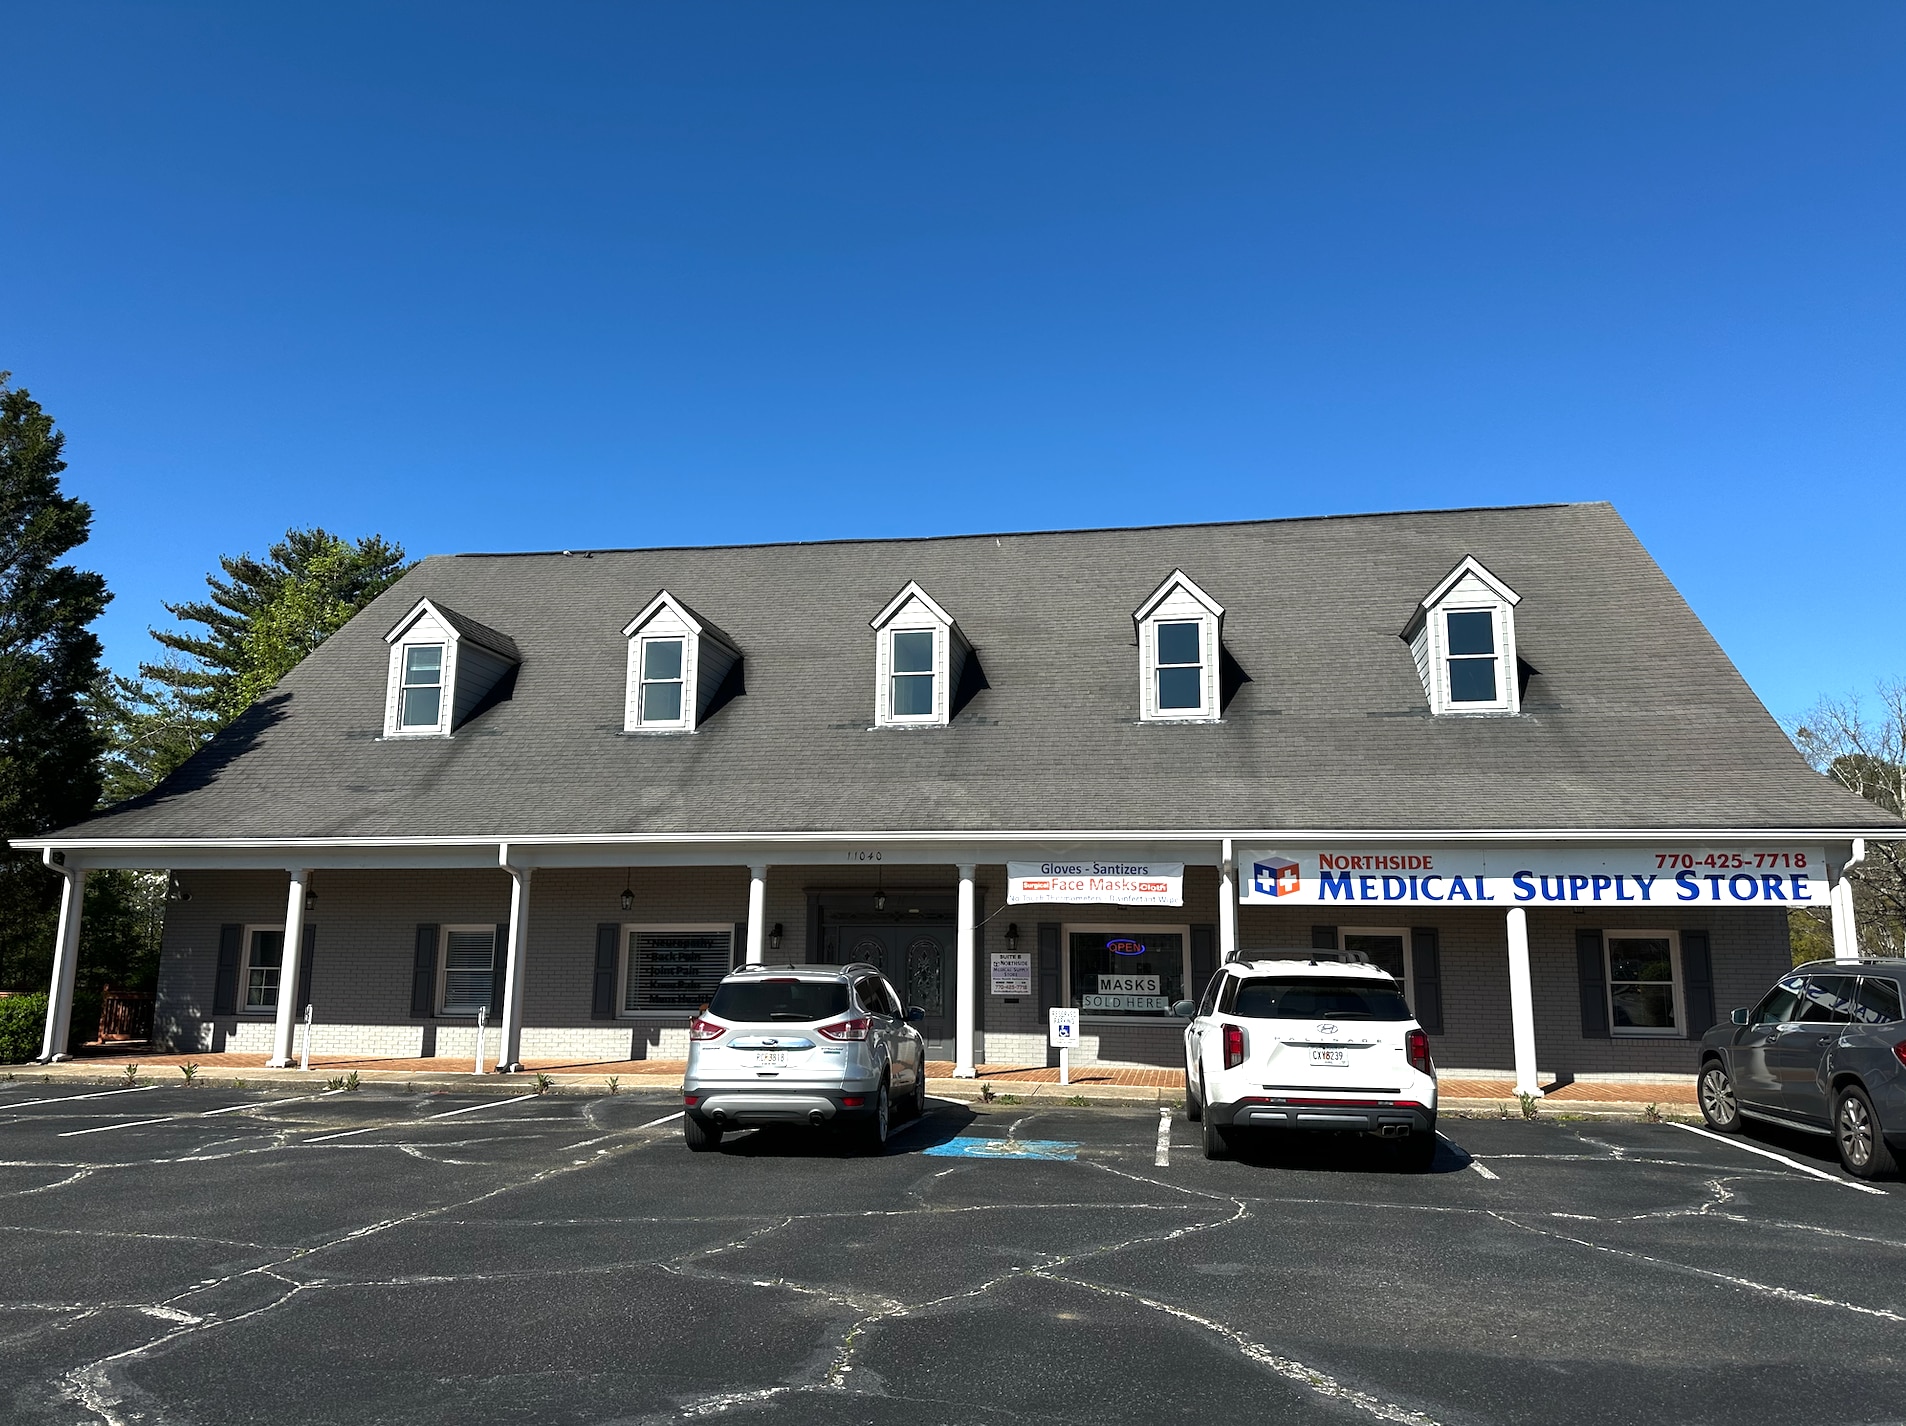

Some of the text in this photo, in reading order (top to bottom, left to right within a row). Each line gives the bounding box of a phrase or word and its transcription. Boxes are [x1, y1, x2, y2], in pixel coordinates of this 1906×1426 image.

[848, 851, 882, 861] 11040
[1318, 854, 1434, 870] NORTHSIDE
[1655, 853, 1807, 868] 770-425-7718
[1041, 863, 1082, 875] Gloves
[1093, 863, 1149, 875] Santizers
[1051, 878, 1084, 891] Face
[1090, 878, 1137, 891] Masks
[1139, 883, 1167, 891] Cloth
[1318, 869, 1812, 901] MEDICAL SUPPLY STORE
[1109, 943, 1141, 952] OPEN
[1101, 980, 1156, 990] MASKS
[1085, 996, 1162, 1008] SOLD HERE
